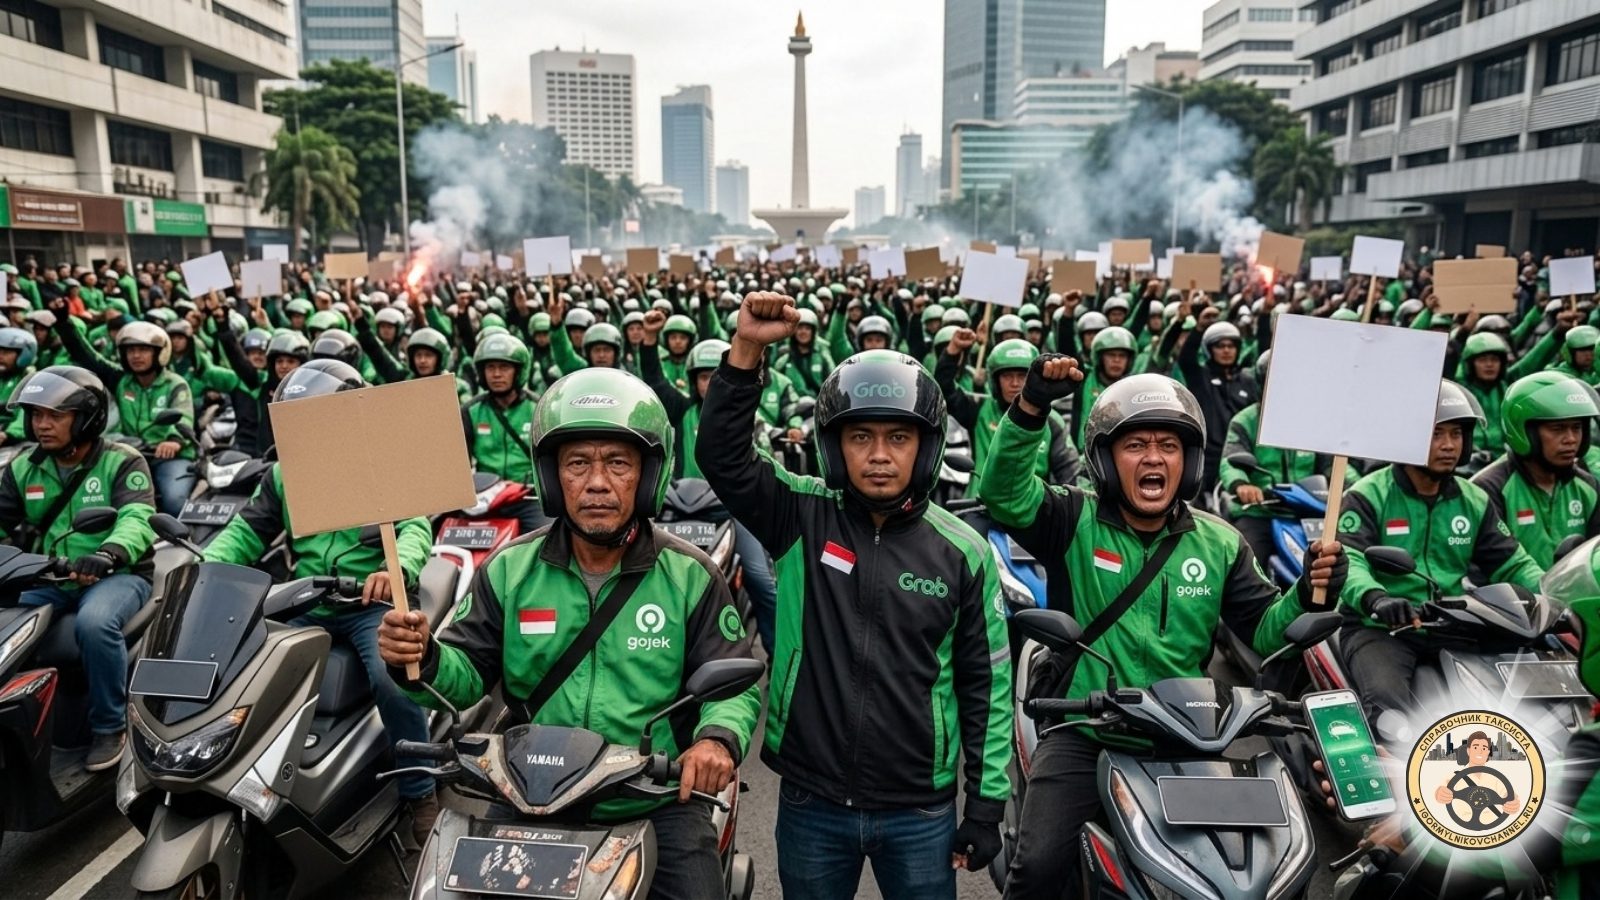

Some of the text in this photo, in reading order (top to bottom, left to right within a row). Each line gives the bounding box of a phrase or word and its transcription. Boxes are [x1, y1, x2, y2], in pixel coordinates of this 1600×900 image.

[853, 379, 906, 398] Grab
[899, 572, 949, 598] Grab
[1176, 584, 1212, 598] gojek
[627, 636, 671, 650] gojek
[526, 754, 565, 767] YAMAHA
